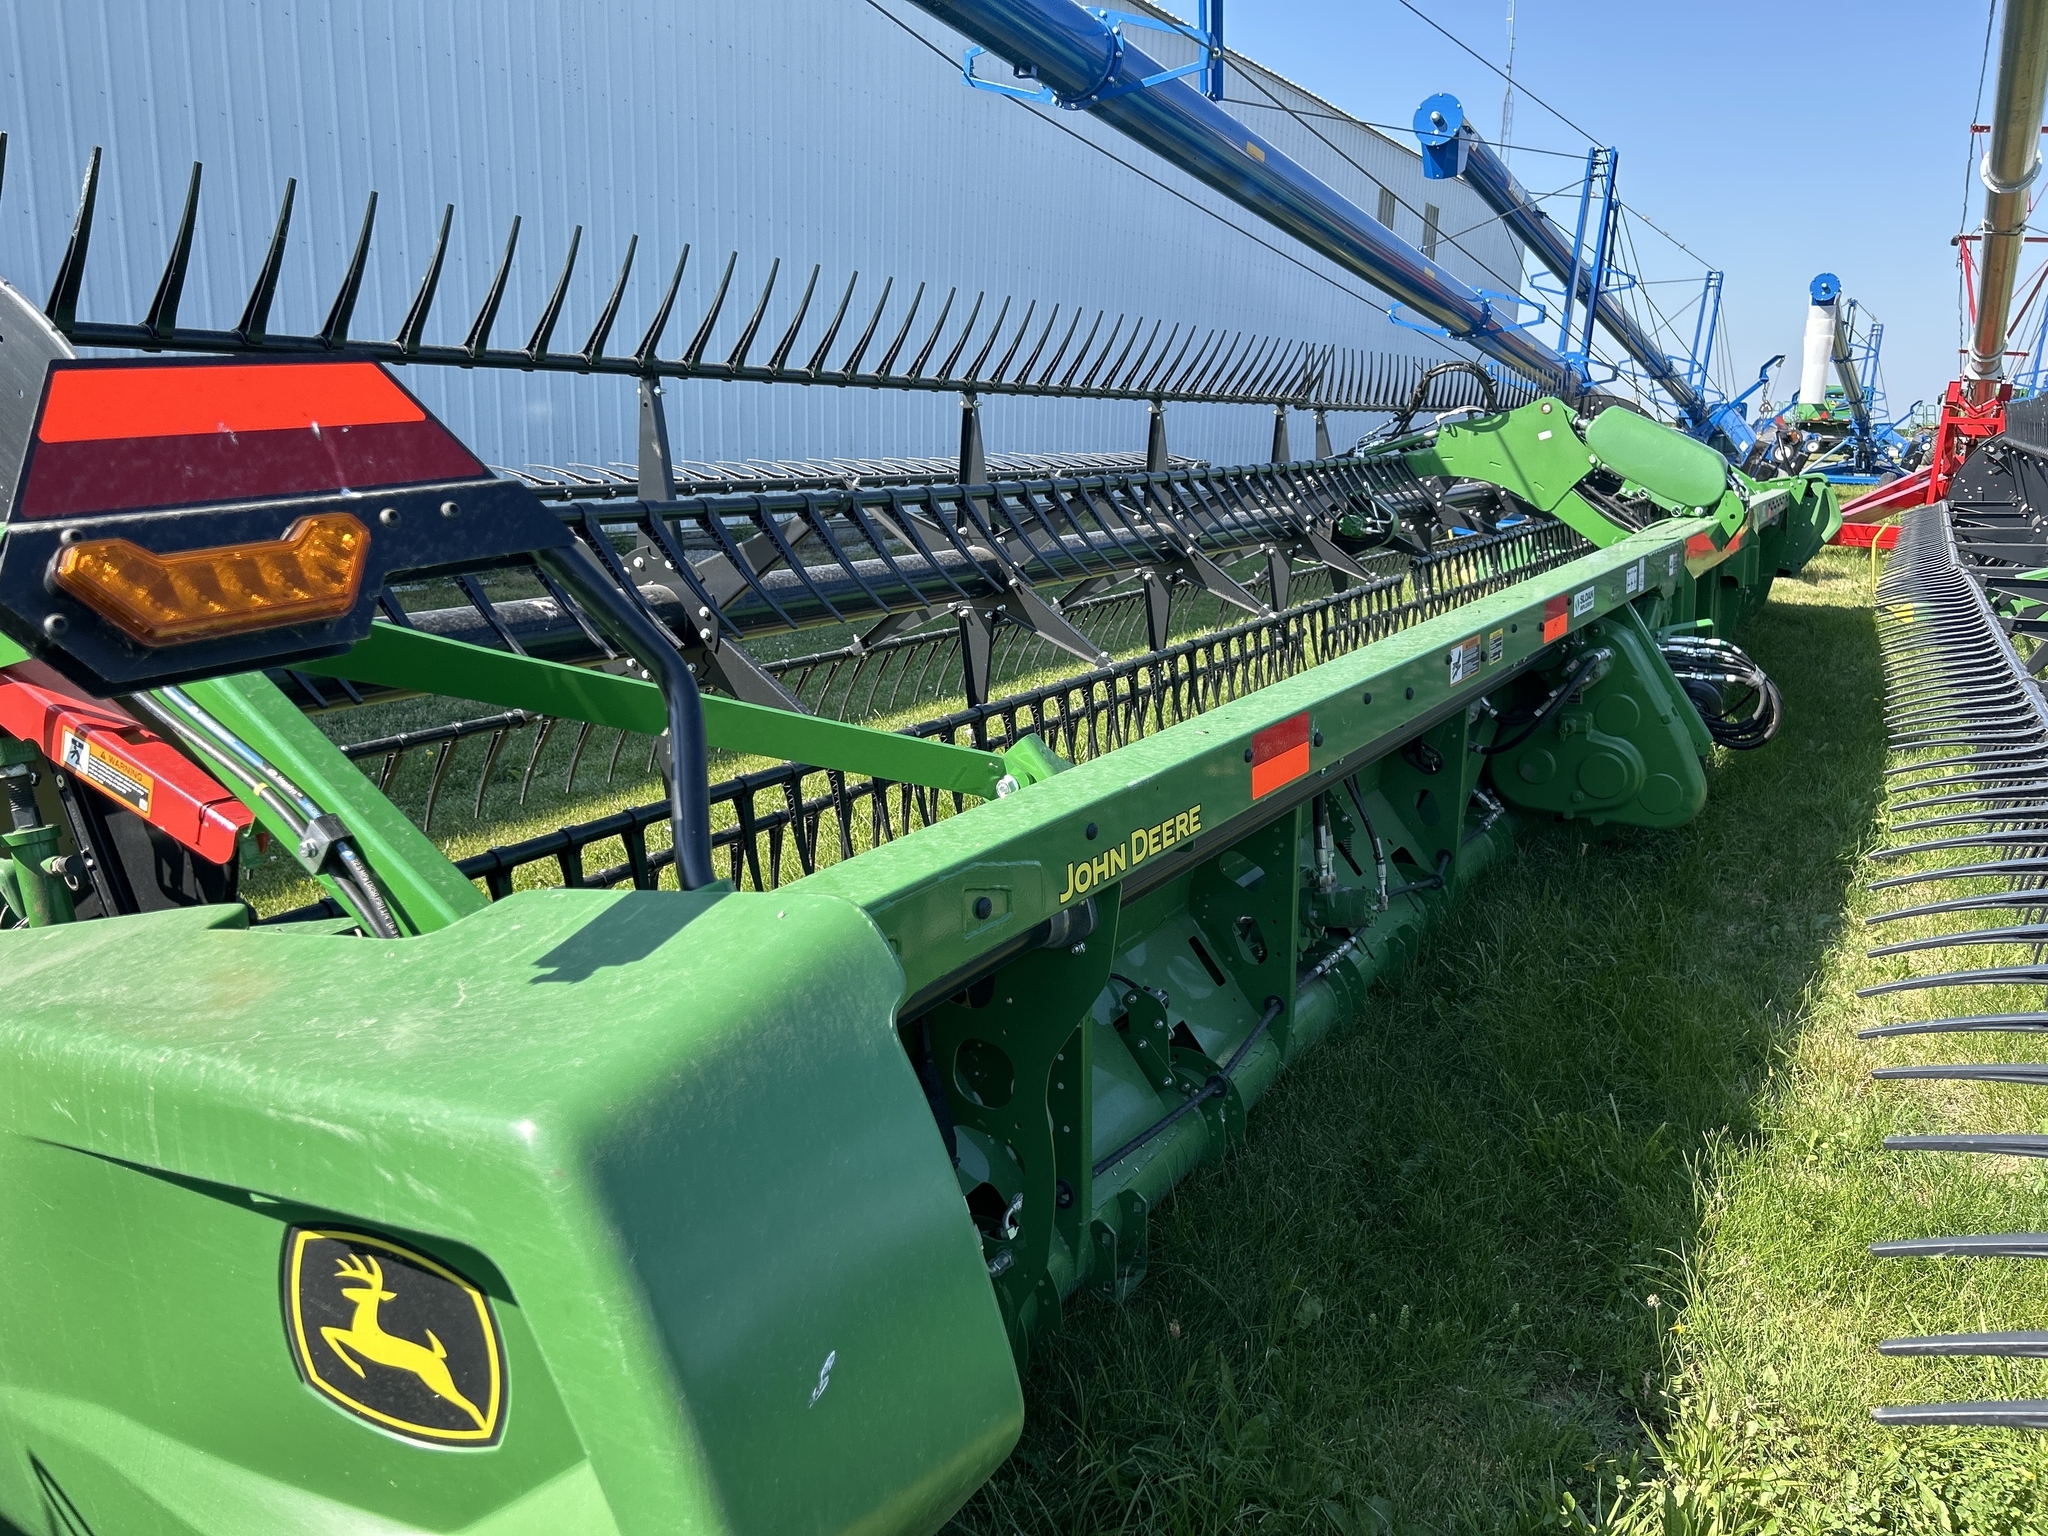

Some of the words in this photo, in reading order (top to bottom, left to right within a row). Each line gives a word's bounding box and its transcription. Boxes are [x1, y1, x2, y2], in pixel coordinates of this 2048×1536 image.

[109, 756, 143, 782] WARNING
[1059, 842, 1127, 904] JOHN
[1131, 803, 1202, 866] DEERE
